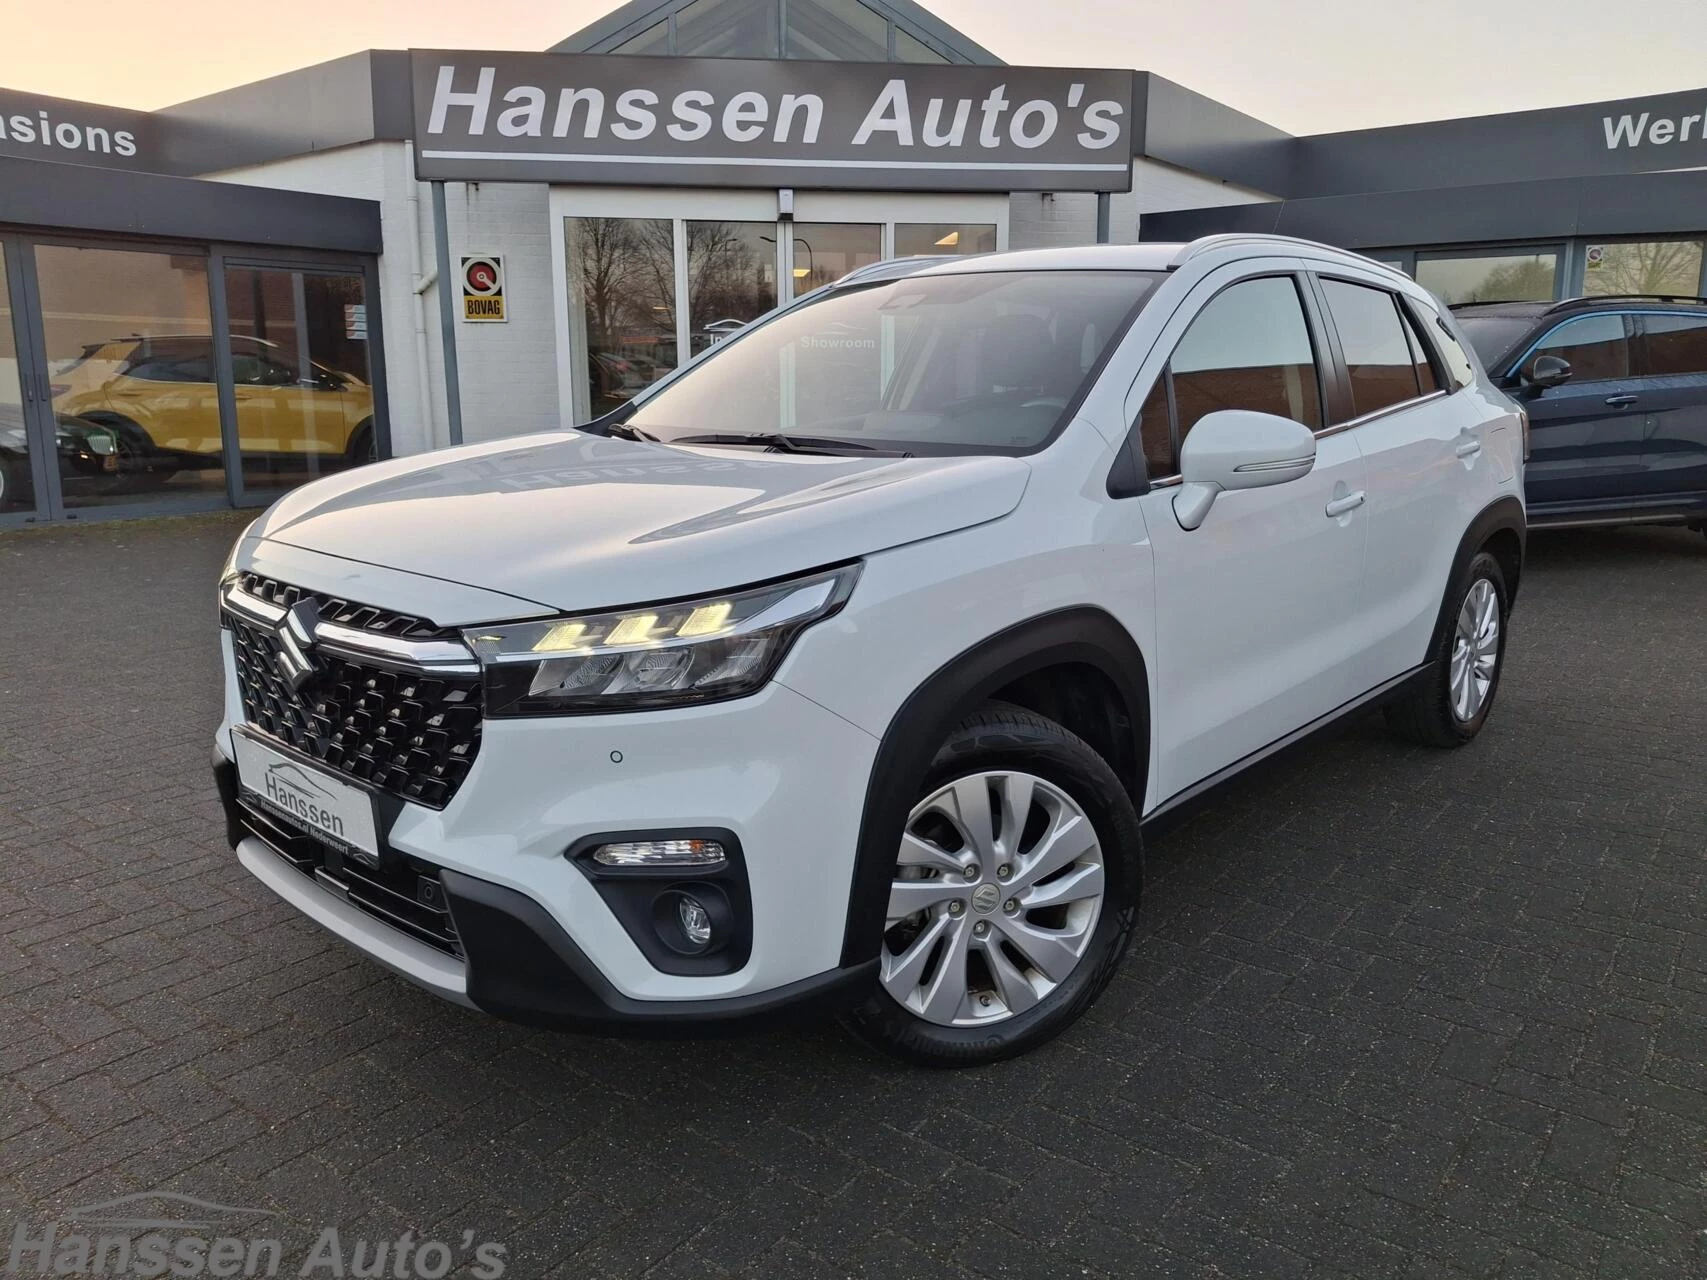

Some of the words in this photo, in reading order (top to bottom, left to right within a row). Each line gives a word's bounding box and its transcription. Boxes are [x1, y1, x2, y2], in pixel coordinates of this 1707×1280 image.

[427, 65, 823, 143] Hanssen
[852, 79, 1124, 149] Auto's
[467, 300, 500, 315] BOVAG
[801, 336, 874, 348] Showroom
[265, 772, 344, 837] Hanssen
